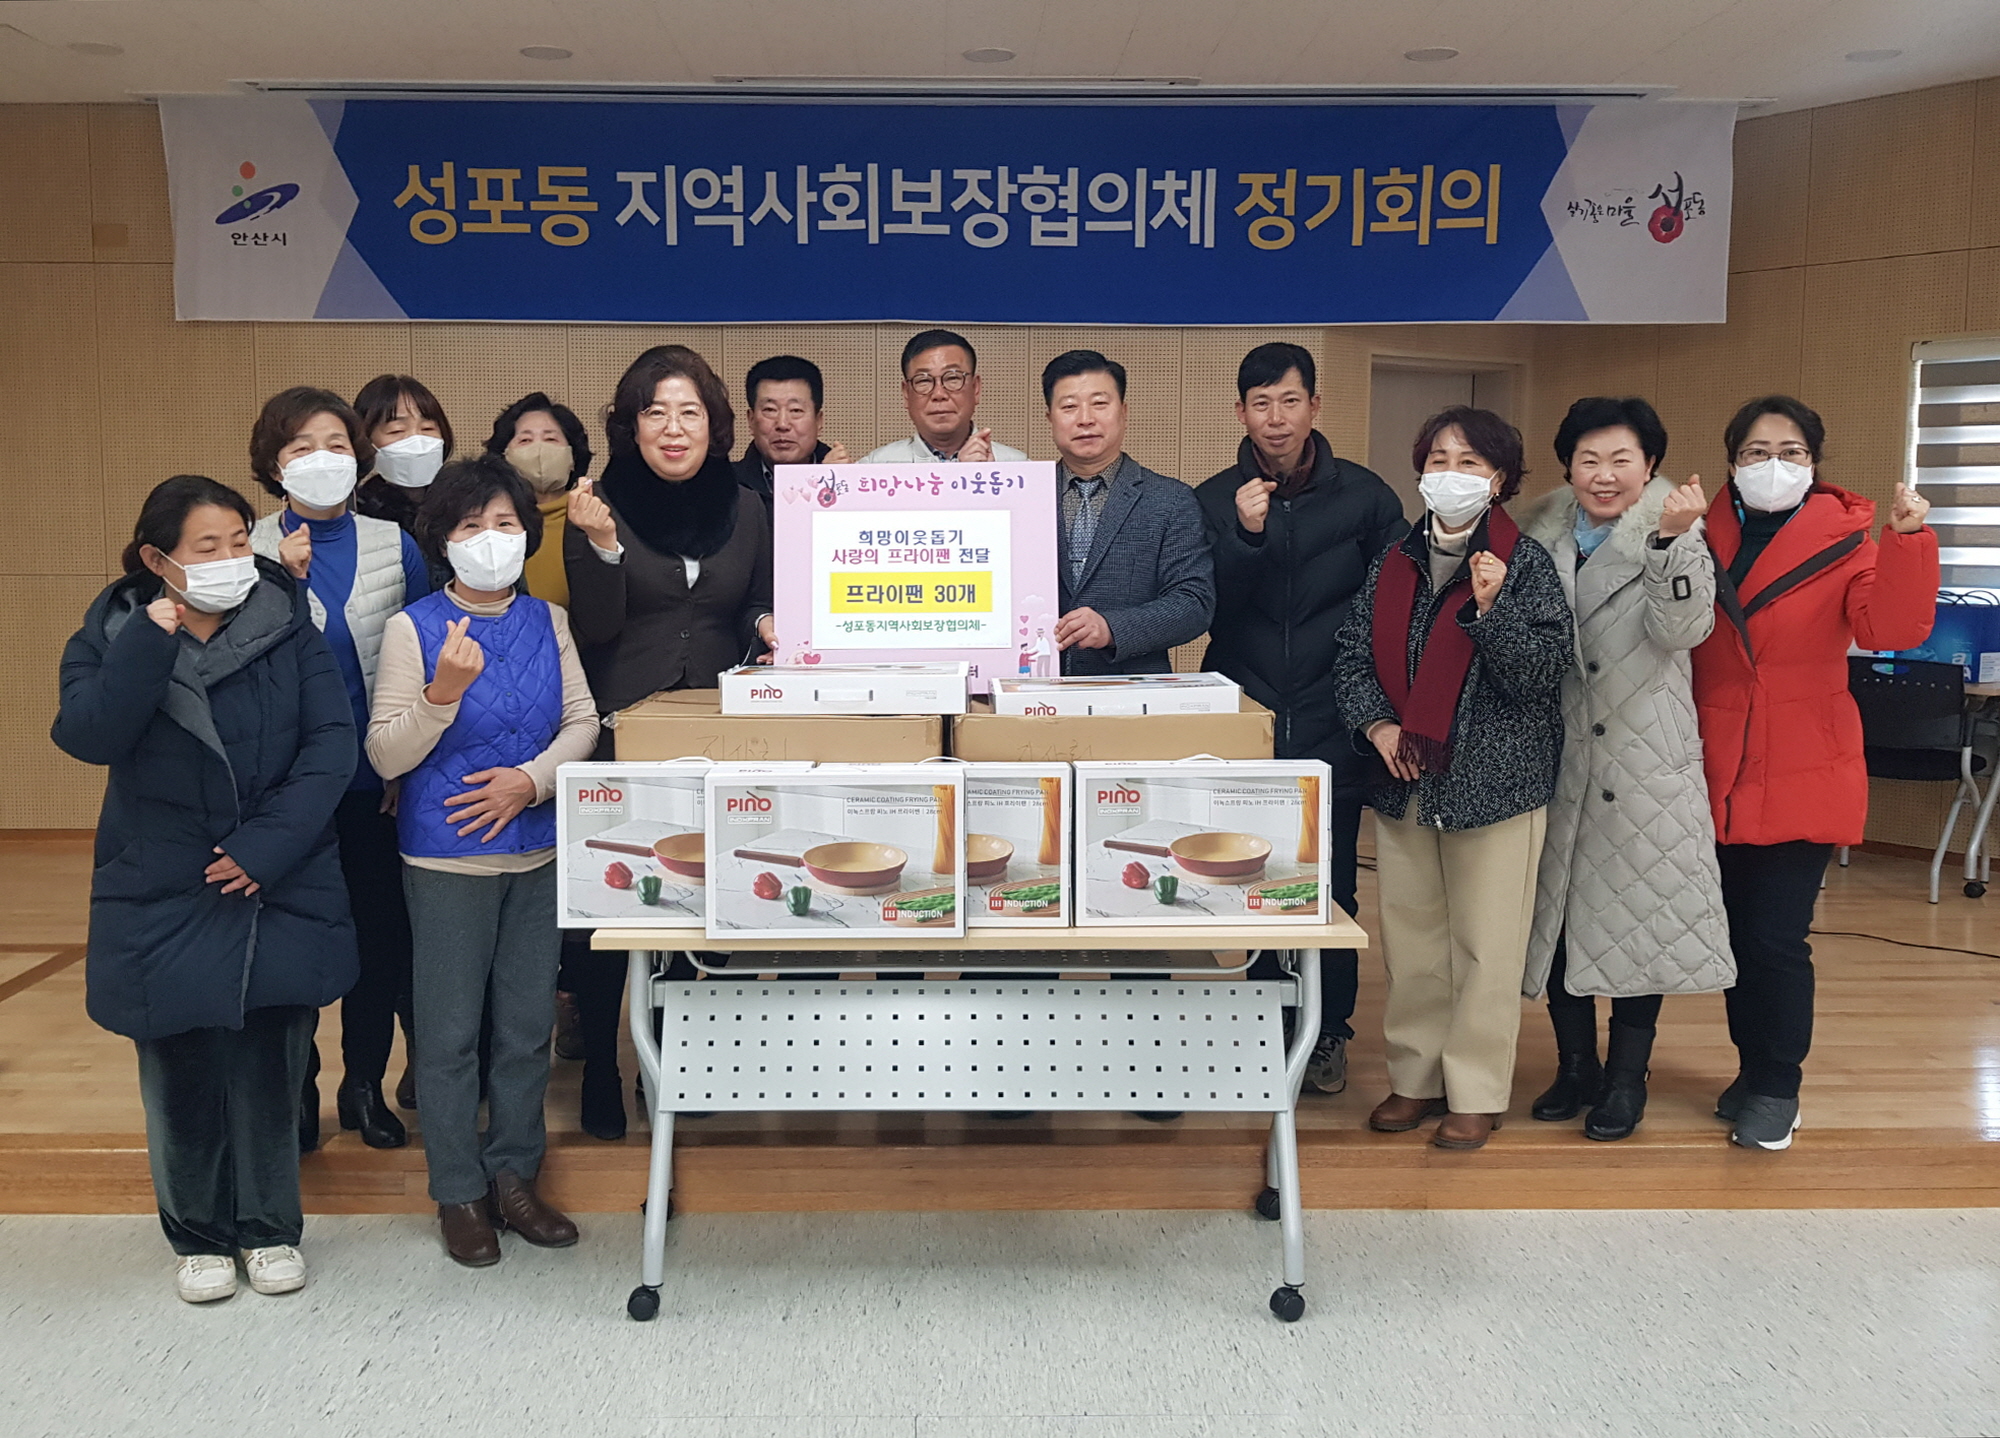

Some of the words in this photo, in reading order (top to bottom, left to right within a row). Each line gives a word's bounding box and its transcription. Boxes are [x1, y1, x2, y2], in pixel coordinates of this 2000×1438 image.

[394, 161, 599, 247] 성포동
[615, 162, 1217, 249] 지역사회보장협의체
[1234, 164, 1501, 250] 정기회의
[1606, 196, 1640, 226] 마을
[231, 232, 287, 246] 안산시
[858, 472, 944, 497] 희망나눔
[951, 471, 1025, 495] 이웃돕기
[858, 530, 964, 546] 희망이웃돕기
[831, 548, 879, 565] 사랑의
[887, 548, 951, 564] 프라이팬
[958, 547, 991, 564] 전달
[846, 584, 924, 604] 프라이팬
[934, 584, 976, 604] 30개
[991, 900, 1002, 908] IH
[1004, 899, 1049, 908] INDUCTION
[1248, 898, 1260, 907] IH
[1262, 897, 1306, 906] INDUCTION
[884, 909, 896, 918] IH
[898, 909, 943, 918] INDUCTION
